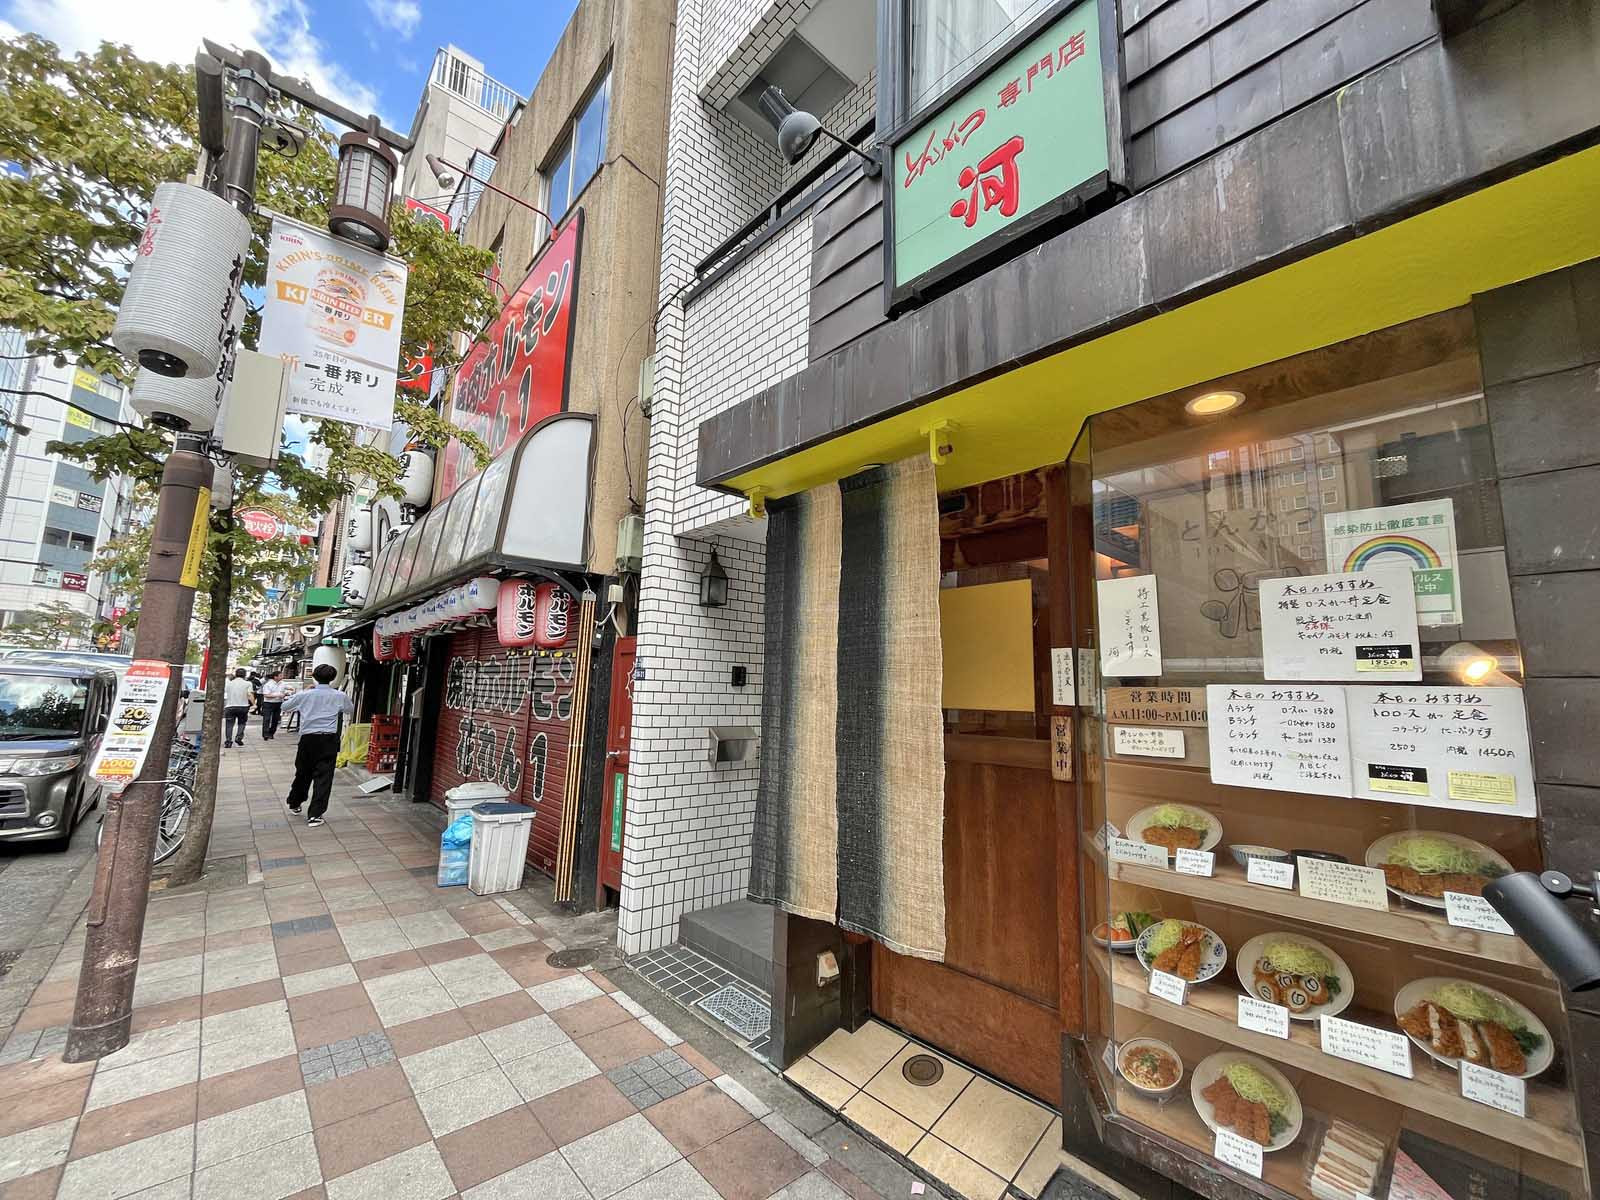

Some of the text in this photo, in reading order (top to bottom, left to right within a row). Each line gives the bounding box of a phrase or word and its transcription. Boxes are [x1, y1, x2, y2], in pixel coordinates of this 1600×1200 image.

[905, 30, 1086, 187] とんかつ 専門店
[950, 136, 1024, 227] 河
[304, 362, 379, 388] 一番搾り
[310, 377, 344, 397] 完成
[1333, 514, 1445, 536] 感染防止徹底宣言
[515, 582, 536, 639] ホルモン
[545, 585, 570, 640] ホルモン
[1129, 690, 1191, 704] 営業時間
[1054, 723, 1069, 772] 営業中
